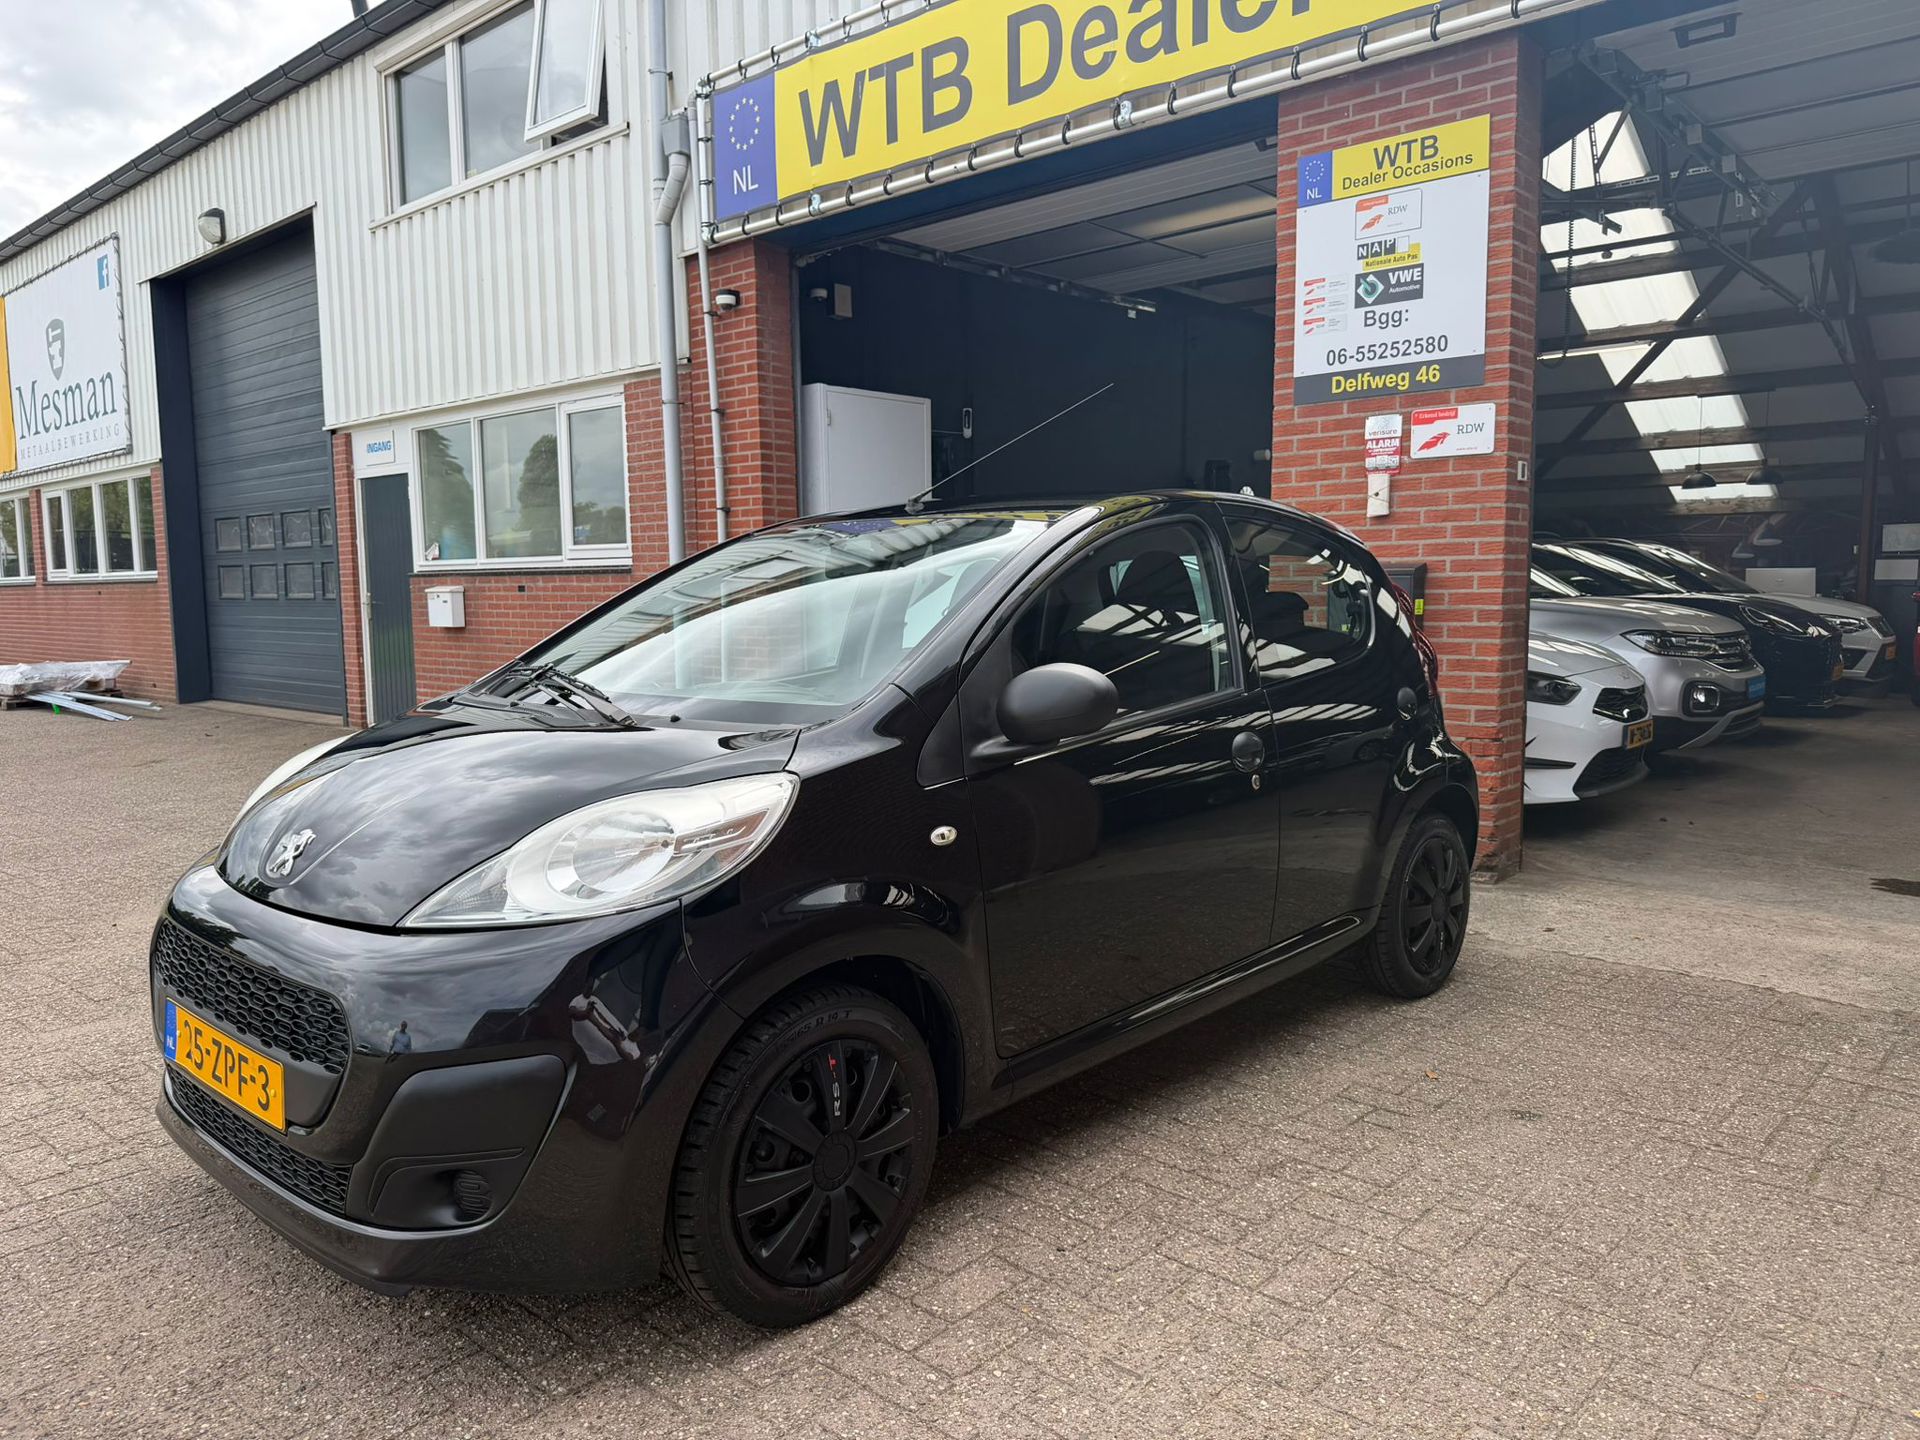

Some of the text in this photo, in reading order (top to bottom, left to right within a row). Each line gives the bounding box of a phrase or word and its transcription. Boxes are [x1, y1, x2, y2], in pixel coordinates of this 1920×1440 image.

[799, 35, 974, 168] WTB
[1373, 134, 1439, 170] WTB
[733, 164, 759, 196] NL
[1342, 153, 1474, 190] Dealer Occasions
[1306, 188, 1322, 200] NL
[1387, 204, 1408, 215] RDW
[1358, 238, 1395, 257] NAP
[1365, 257, 1392, 267] Nationale
[1393, 255, 1406, 263] Auto
[1388, 268, 1422, 285] VWE
[1389, 285, 1420, 293] Automotive
[1363, 307, 1409, 329] Bgg:
[1326, 334, 1449, 366] 06-55252580
[1331, 365, 1441, 394] Delfweg 46
[16, 371, 117, 440] Mesman
[1369, 429, 1398, 437] verisure
[1456, 423, 1485, 435] RDW
[20, 423, 121, 459] METAALBEWERKING
[367, 440, 392, 453] INGANG
[1366, 439, 1400, 449] ALARM
[184, 1019, 270, 1111] 25-ZPF-3
